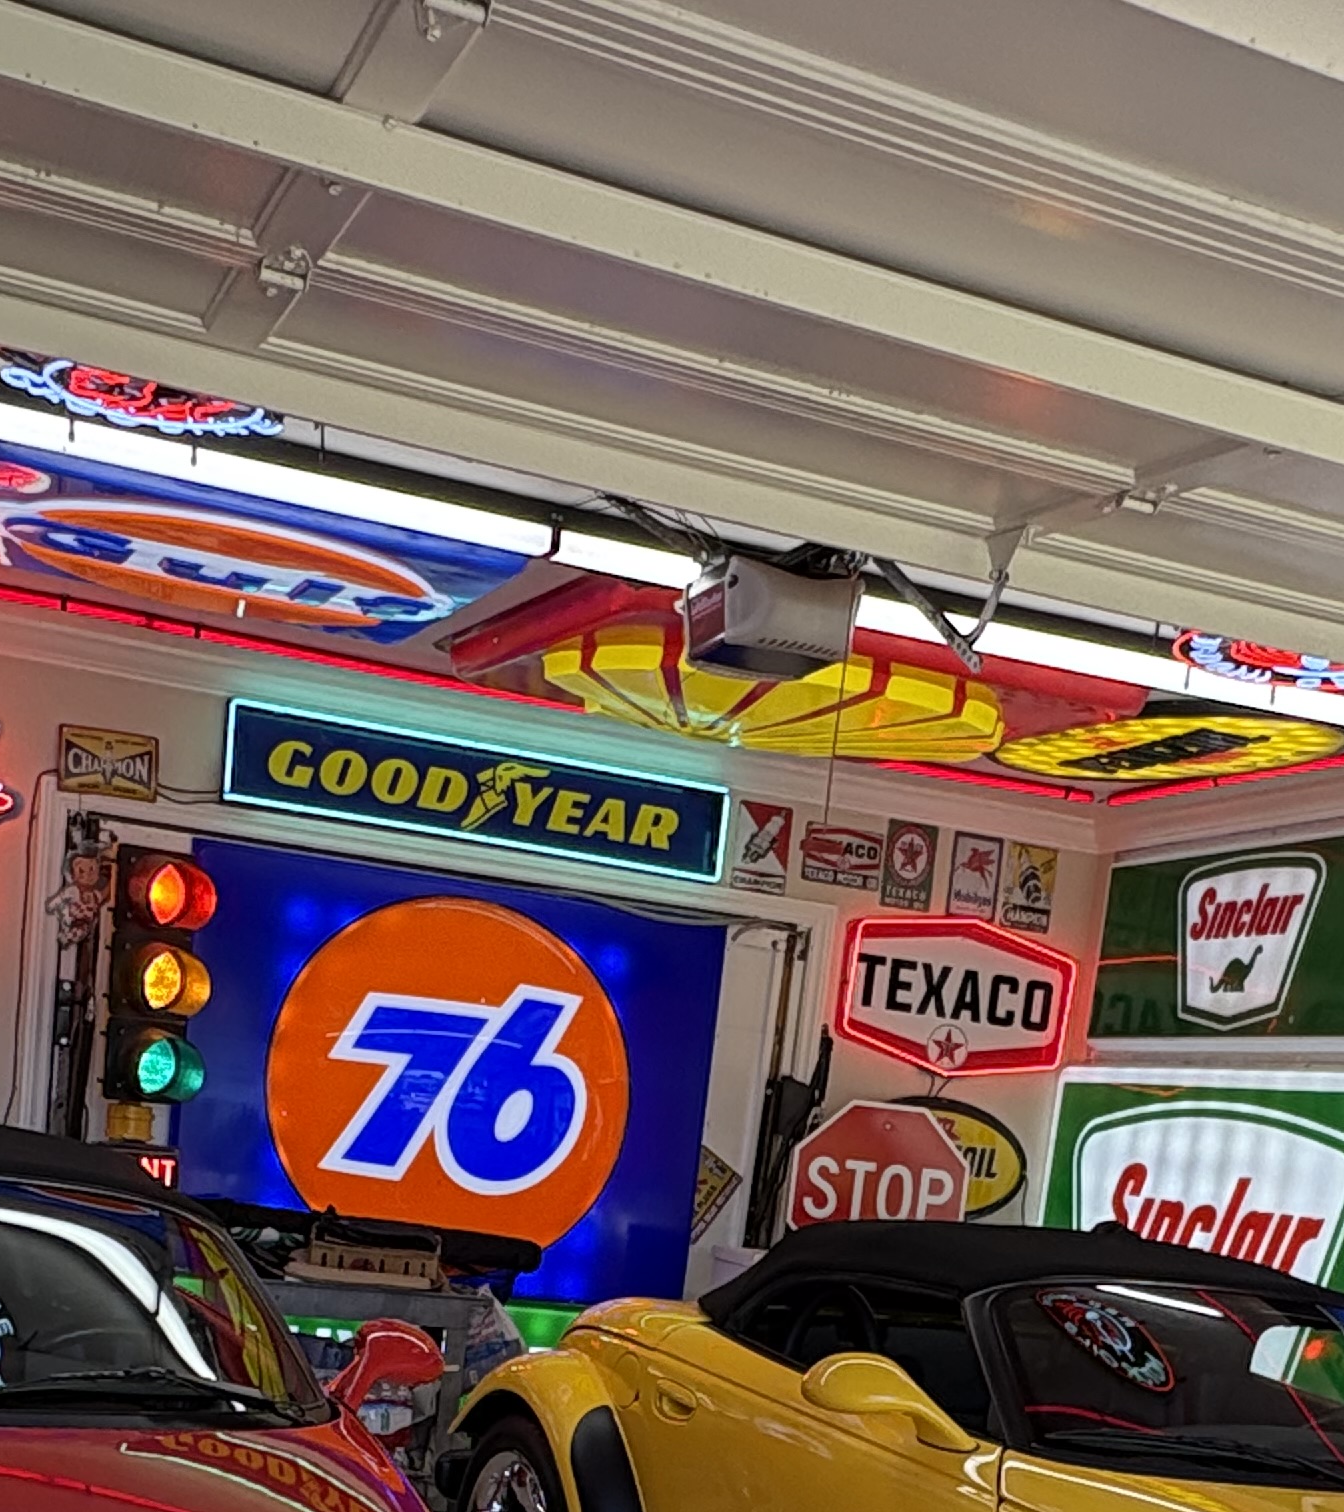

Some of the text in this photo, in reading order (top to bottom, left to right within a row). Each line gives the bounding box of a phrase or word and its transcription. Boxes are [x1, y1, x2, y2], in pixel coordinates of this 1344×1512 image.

[1190, 886, 1305, 941] Sinclair
[856, 954, 1054, 1033] TEXACO
[317, 984, 587, 1197] 76
[802, 1155, 955, 1221] STOP
